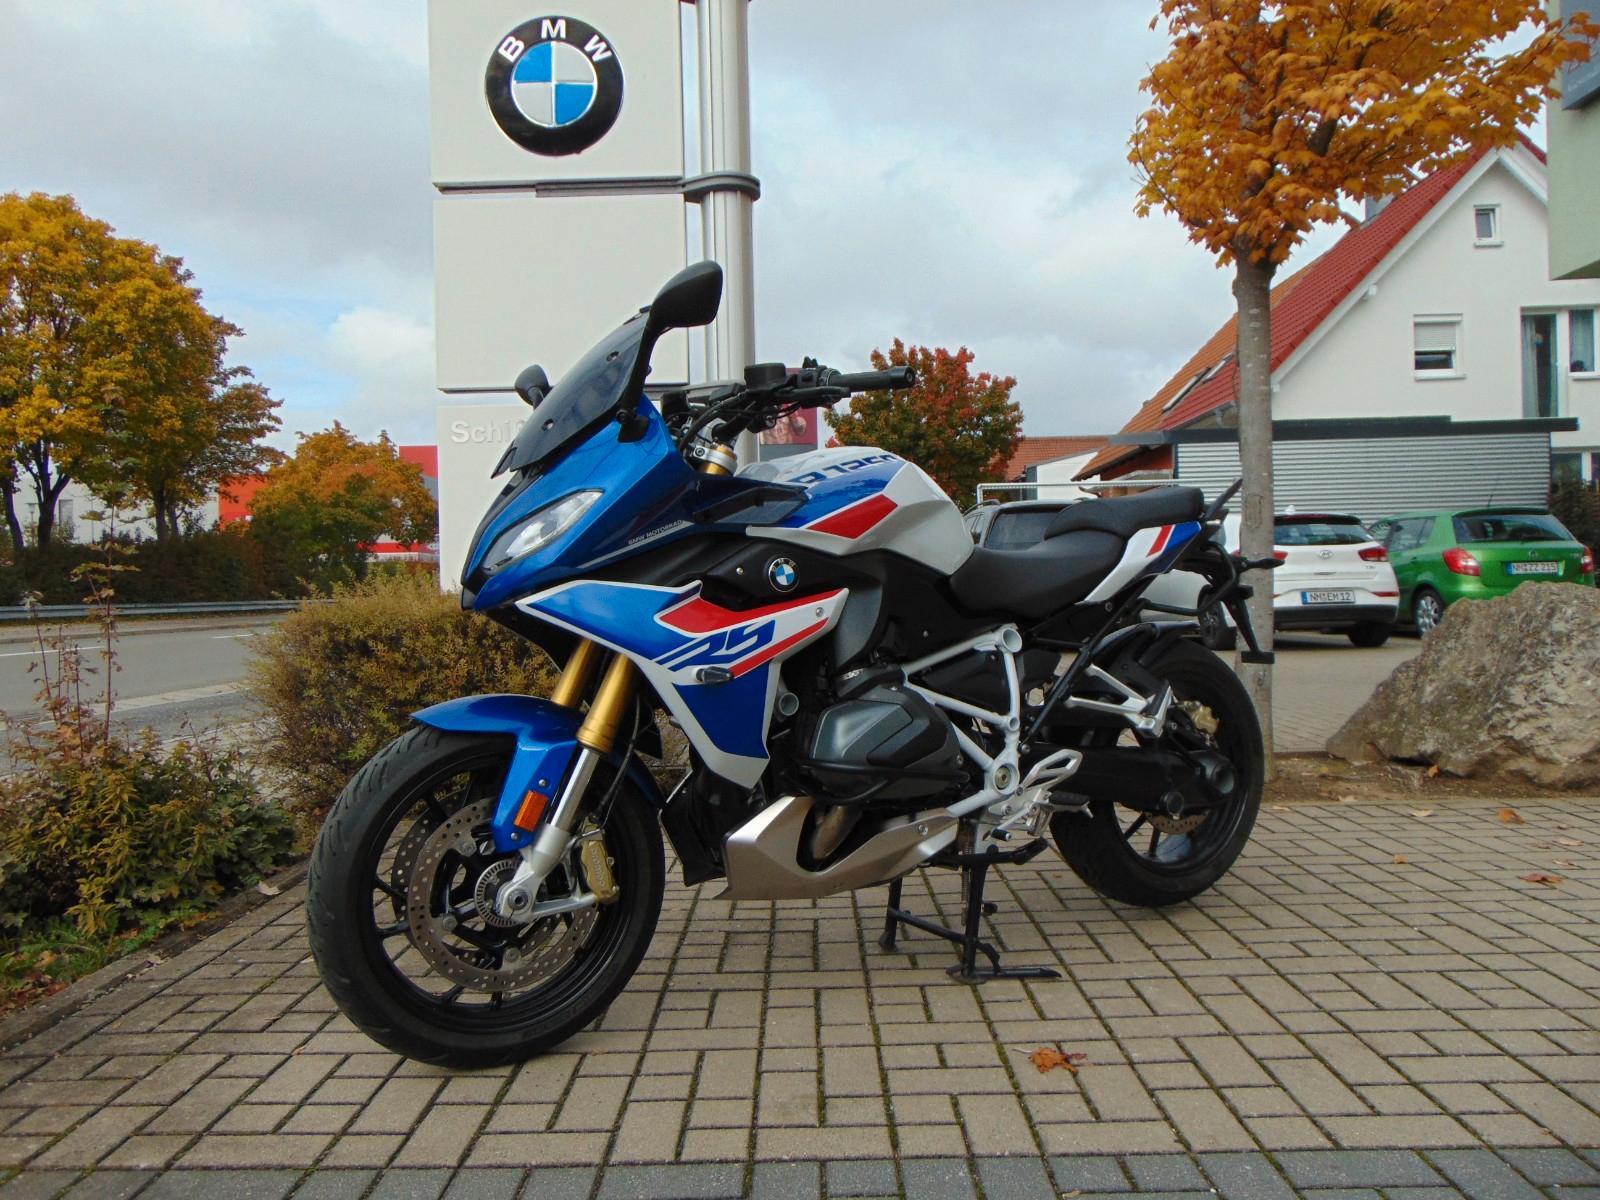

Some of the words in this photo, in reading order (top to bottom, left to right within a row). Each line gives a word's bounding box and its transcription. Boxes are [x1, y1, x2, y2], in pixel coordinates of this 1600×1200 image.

[498, 18, 613, 63] BMW
[628, 534, 646, 546] BMW
[646, 519, 684, 539] MOTORRAD
[655, 619, 776, 673] RS
